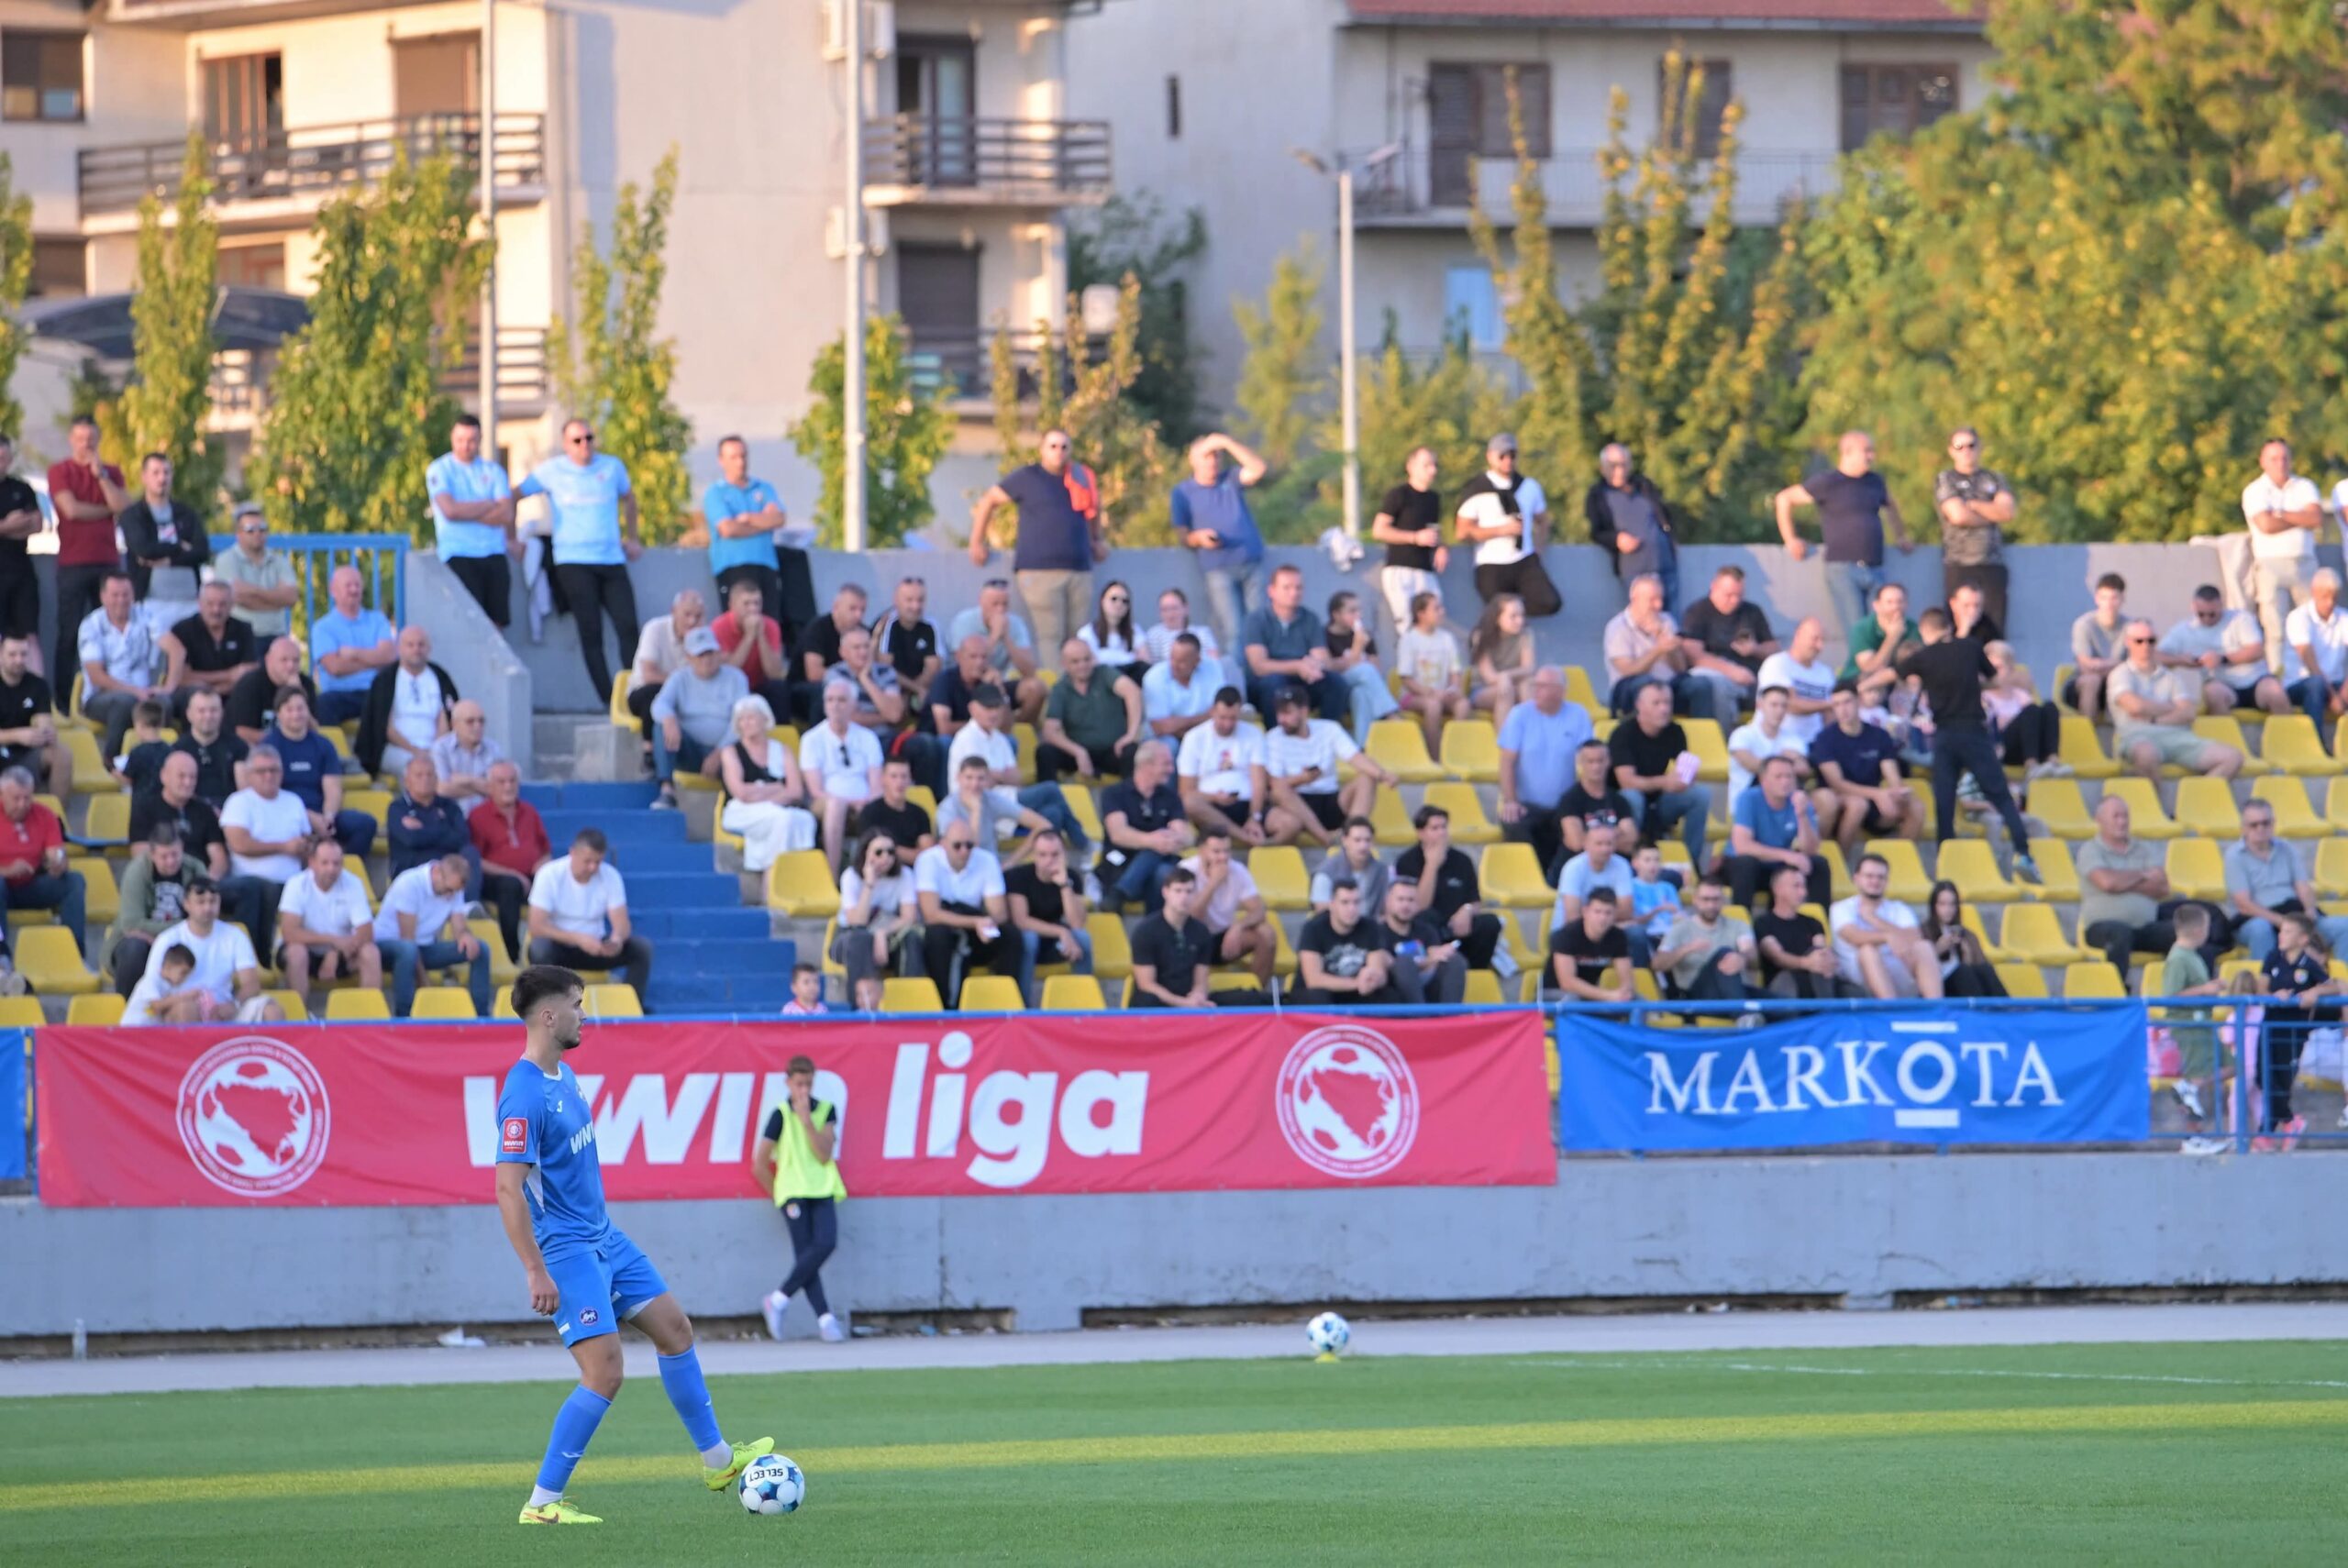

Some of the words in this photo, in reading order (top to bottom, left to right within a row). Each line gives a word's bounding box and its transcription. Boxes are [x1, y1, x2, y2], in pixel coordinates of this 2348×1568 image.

[882, 1031, 1149, 1188] liga
[1644, 1039, 2065, 1115] MARKOTA
[749, 1468, 783, 1481] SELECT
